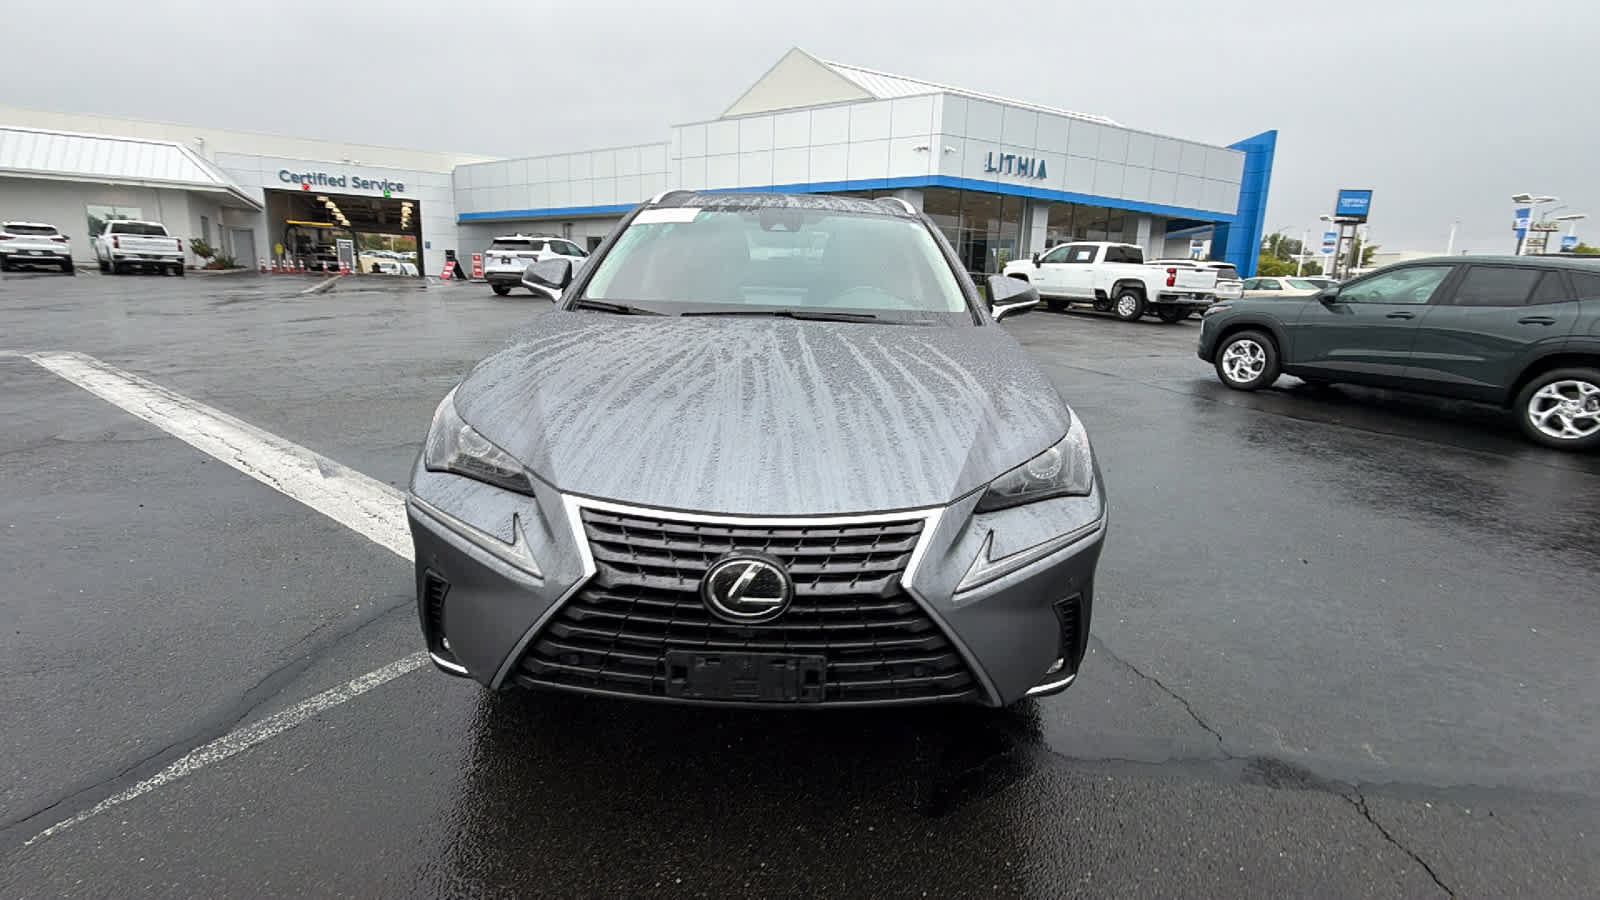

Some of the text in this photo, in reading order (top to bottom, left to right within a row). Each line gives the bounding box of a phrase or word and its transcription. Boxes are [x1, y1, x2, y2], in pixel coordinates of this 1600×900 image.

[986, 151, 1047, 179] LITHIA
[279, 169, 405, 193] Certified Service
